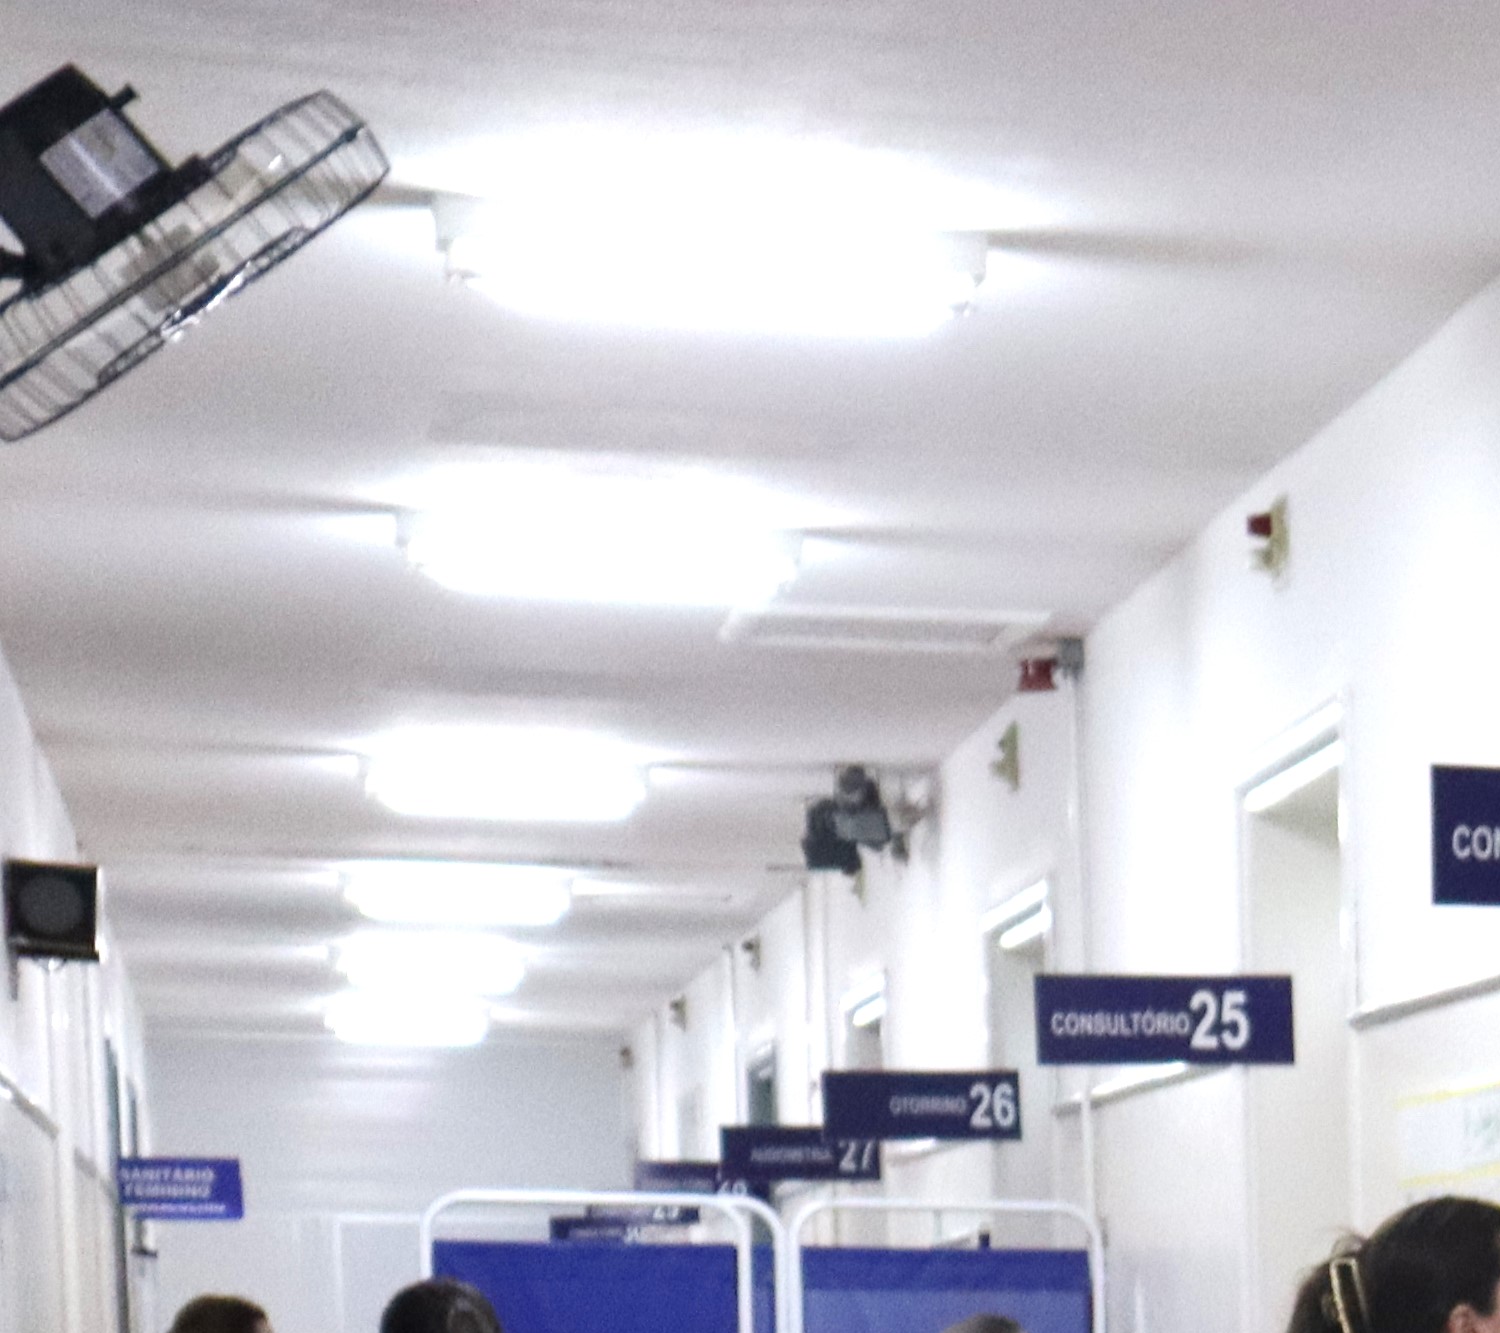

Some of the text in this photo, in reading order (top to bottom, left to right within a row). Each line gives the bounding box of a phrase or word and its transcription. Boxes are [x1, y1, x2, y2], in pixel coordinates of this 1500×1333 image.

[1050, 989, 1250, 1050] CONSULTÓRIO 25
[969, 1082, 1016, 1130] 26
[838, 1139, 876, 1172] 27
